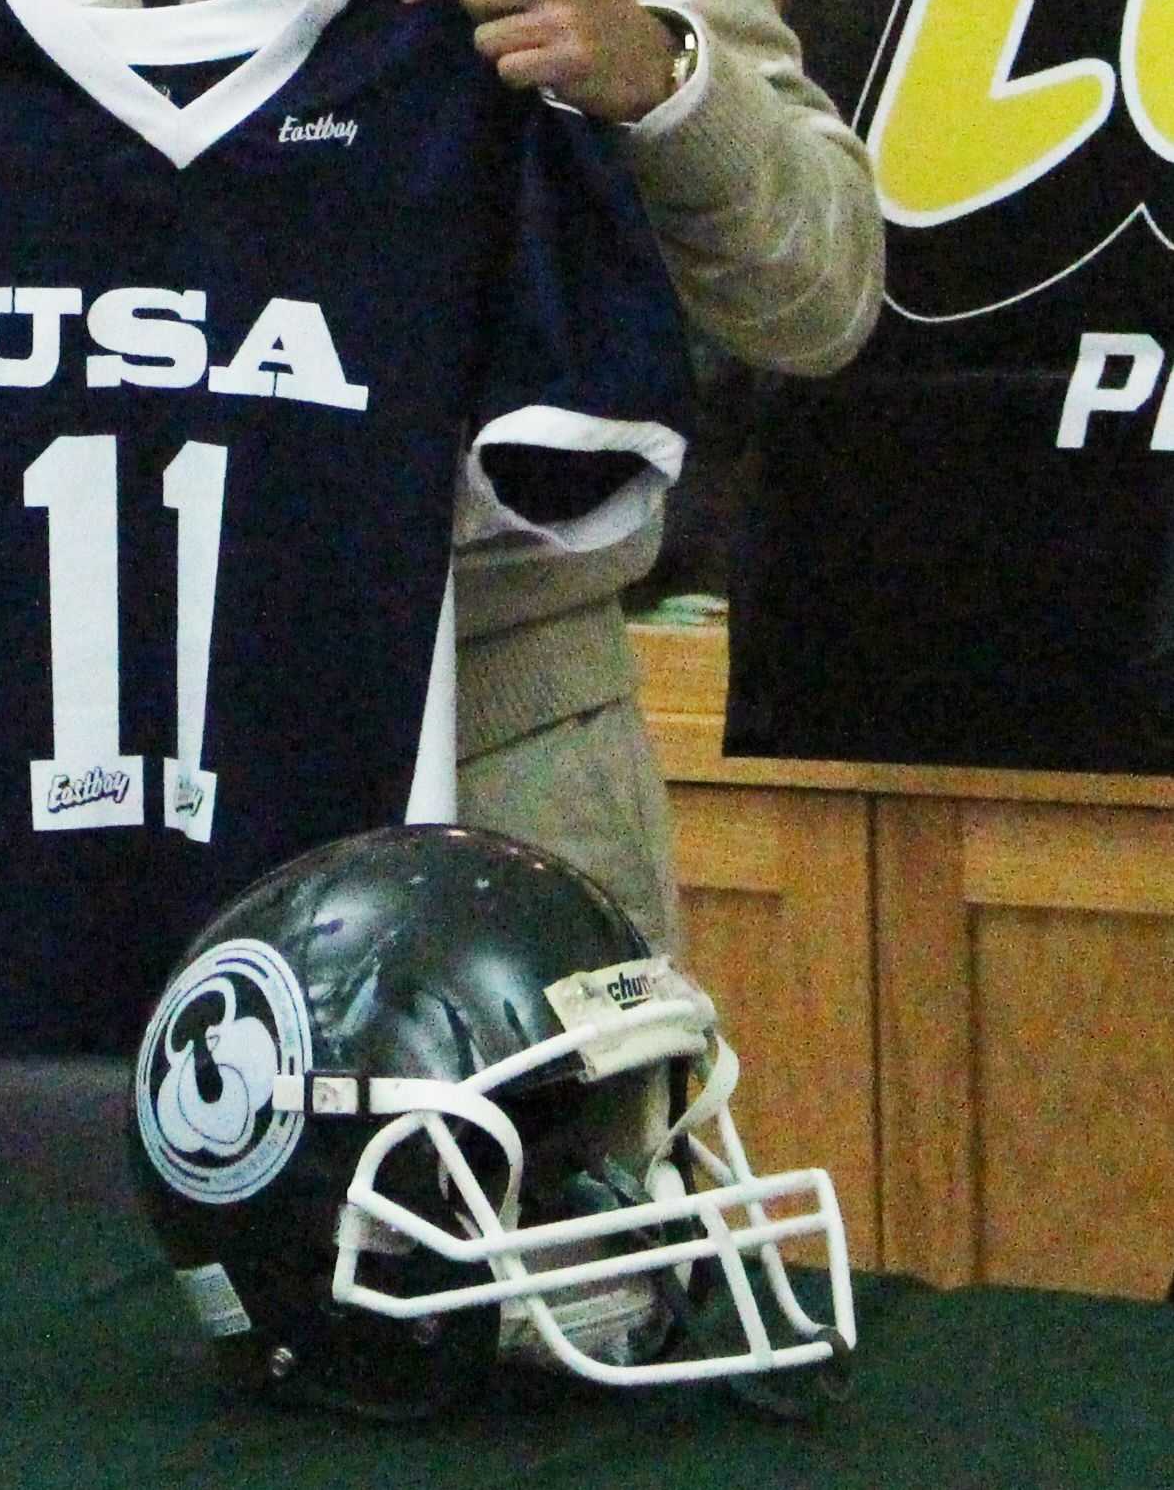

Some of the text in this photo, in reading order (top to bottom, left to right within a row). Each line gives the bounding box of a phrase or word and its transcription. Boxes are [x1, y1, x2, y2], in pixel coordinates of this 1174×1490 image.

[278, 113, 358, 147] Eastbay
[23, 434, 228, 843] 11
[48, 766, 130, 814] Eastbay
